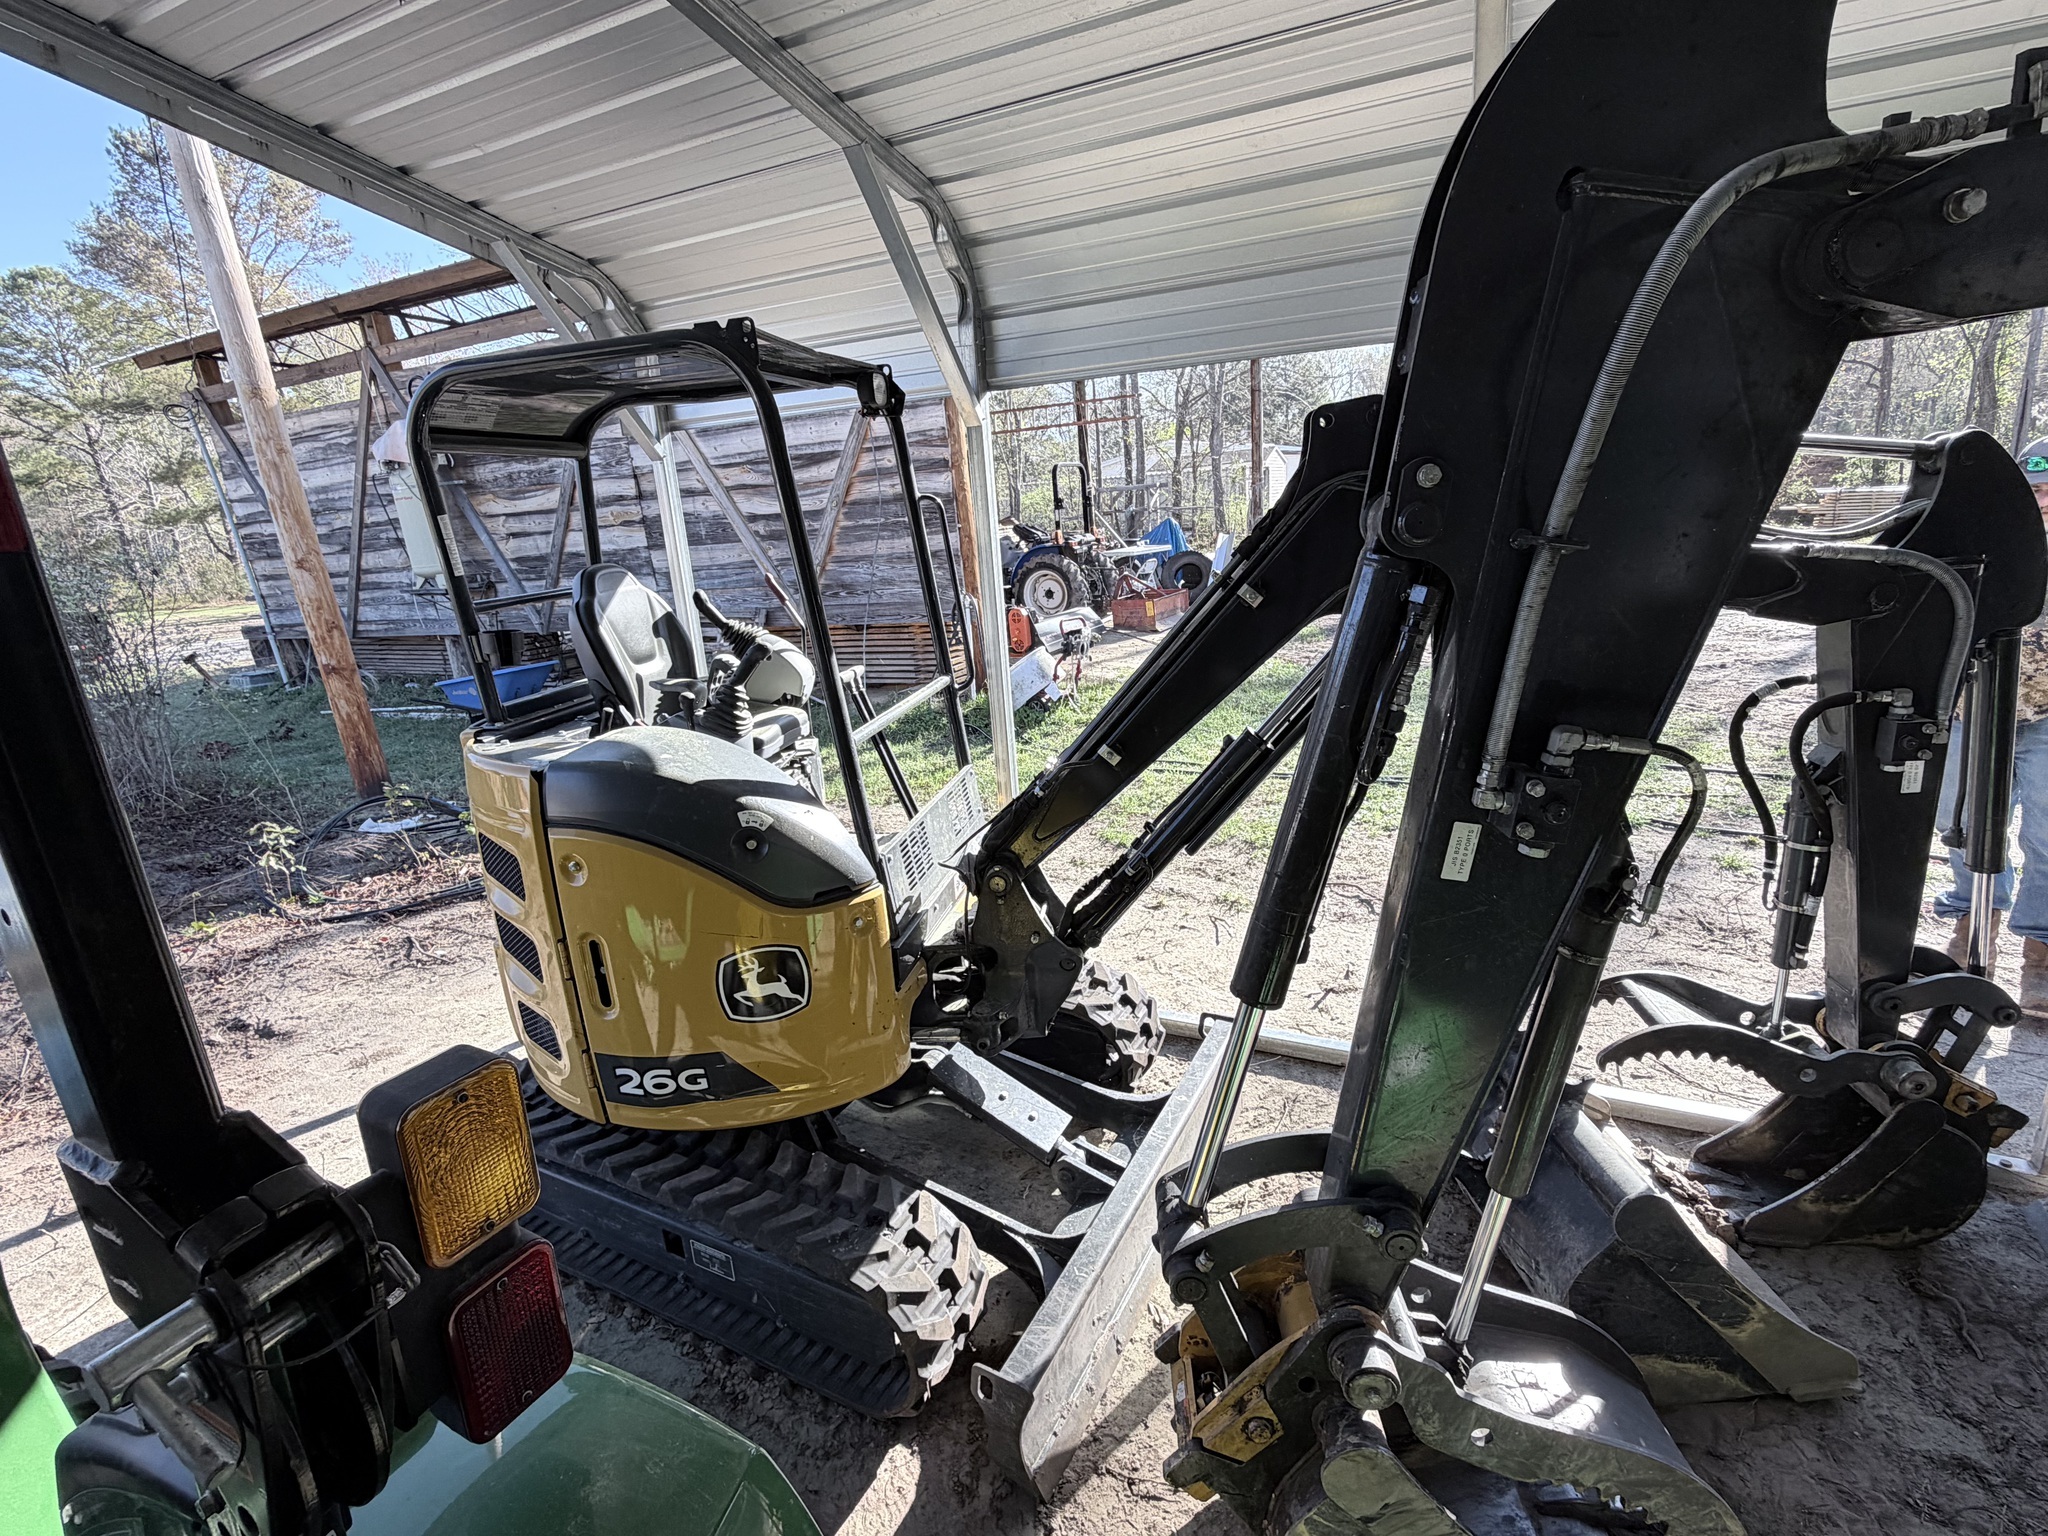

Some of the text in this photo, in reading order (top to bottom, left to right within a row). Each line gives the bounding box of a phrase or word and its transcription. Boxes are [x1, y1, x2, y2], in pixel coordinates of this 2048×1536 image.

[1453, 836, 1464, 855] B2351
[1457, 858, 1467, 875] TYPE
[1463, 829, 1475, 852] PORTS
[614, 1067, 709, 1095] 26G
